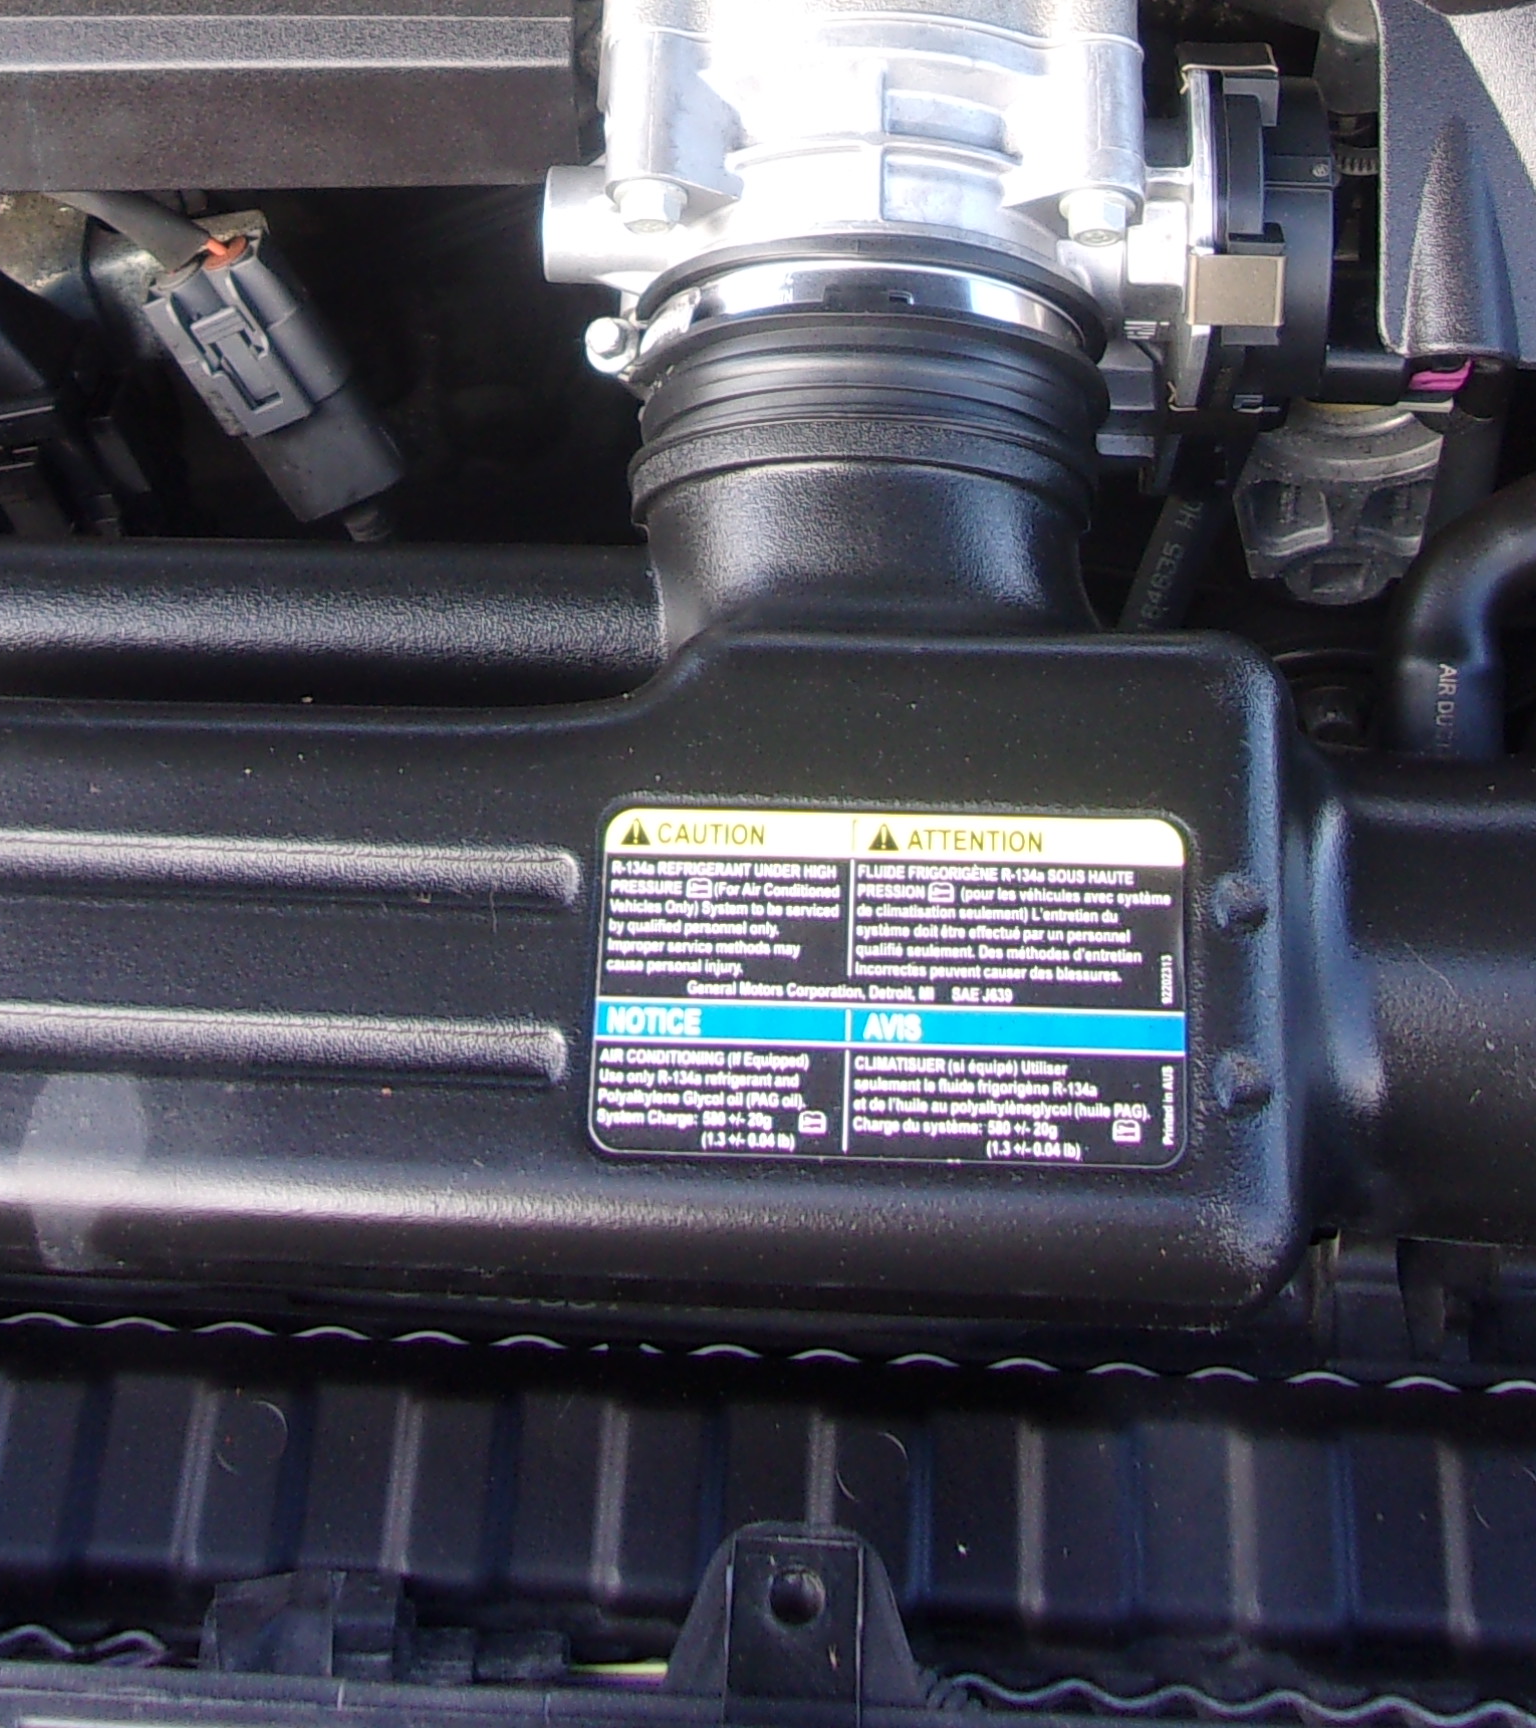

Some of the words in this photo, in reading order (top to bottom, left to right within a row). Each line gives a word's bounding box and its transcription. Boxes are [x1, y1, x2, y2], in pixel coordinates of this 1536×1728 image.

[1437, 663, 1458, 696] AIR
[657, 822, 765, 845] CAUTION
[907, 828, 1043, 853] ATTENTION
[611, 860, 656, 875] R-134a
[656, 861, 752, 877] REFRIGERANT
[753, 863, 801, 878] UNDER
[803, 864, 837, 879] HIGH
[857, 864, 905, 879] FLUIDE
[1001, 867, 1045, 883] R-134a
[1047, 868, 1085, 884] SOUS
[1088, 869, 1134, 885] HAUTE
[610, 879, 683, 895] PRESSURE
[713, 881, 740, 898] (For
[742, 882, 762, 897] Air
[762, 882, 840, 899] Conditioned
[856, 884, 926, 899] PRESSION
[960, 887, 995, 903] (pour
[997, 887, 1016, 901] les
[1018, 888, 1081, 903] véhicules
[1083, 891, 1114, 904] avec
[1116, 891, 1171, 907] système
[608, 898, 662, 914] Vehicles
[664, 899, 700, 917] Only)
[701, 900, 748, 918] System
[750, 901, 764, 916] to
[765, 902, 783, 917] be
[785, 902, 840, 918] serviced
[856, 903, 873, 918] de
[875, 904, 956, 920] climatisation
[958, 905, 1028, 922] seulement)
[1031, 907, 1098, 923] L'entretien
[1101, 909, 1118, 923] du
[607, 918, 624, 934] by
[626, 918, 681, 935] qualified
[683, 920, 747, 937] personnel
[748, 921, 780, 938] only.
[606, 938, 665, 955] Improper
[667, 940, 713, 955] service
[715, 941, 771, 956] methods
[772, 944, 801, 959] may
[604, 959, 644, 971] cause
[646, 958, 702, 975] personal
[704, 960, 744, 976] injury.
[1160, 954, 1173, 1005] 92202313
[686, 980, 736, 996] General
[738, 981, 784, 998] Motors
[786, 982, 865, 1000] Corporation,
[867, 984, 916, 1001] Detroit,
[918, 985, 934, 1002] MI
[951, 986, 980, 1003] SAE
[981, 987, 1013, 1004] J639
[605, 1006, 702, 1036] NOTICE
[862, 1012, 923, 1042] AVIS
[599, 1047, 624, 1063] AIR
[625, 1048, 725, 1066] CONDITIONING
[727, 1051, 742, 1067] (If
[743, 1051, 809, 1070] Equipped)
[598, 1067, 624, 1083] Use
[626, 1068, 655, 1086] only
[656, 1069, 703, 1085] R-134a
[704, 1070, 772, 1089] refrigerant
[773, 1072, 800, 1088] and
[1162, 1065, 1174, 1090] AUS
[1162, 1092, 1174, 1102] in
[1162, 1105, 1174, 1145] Printed
